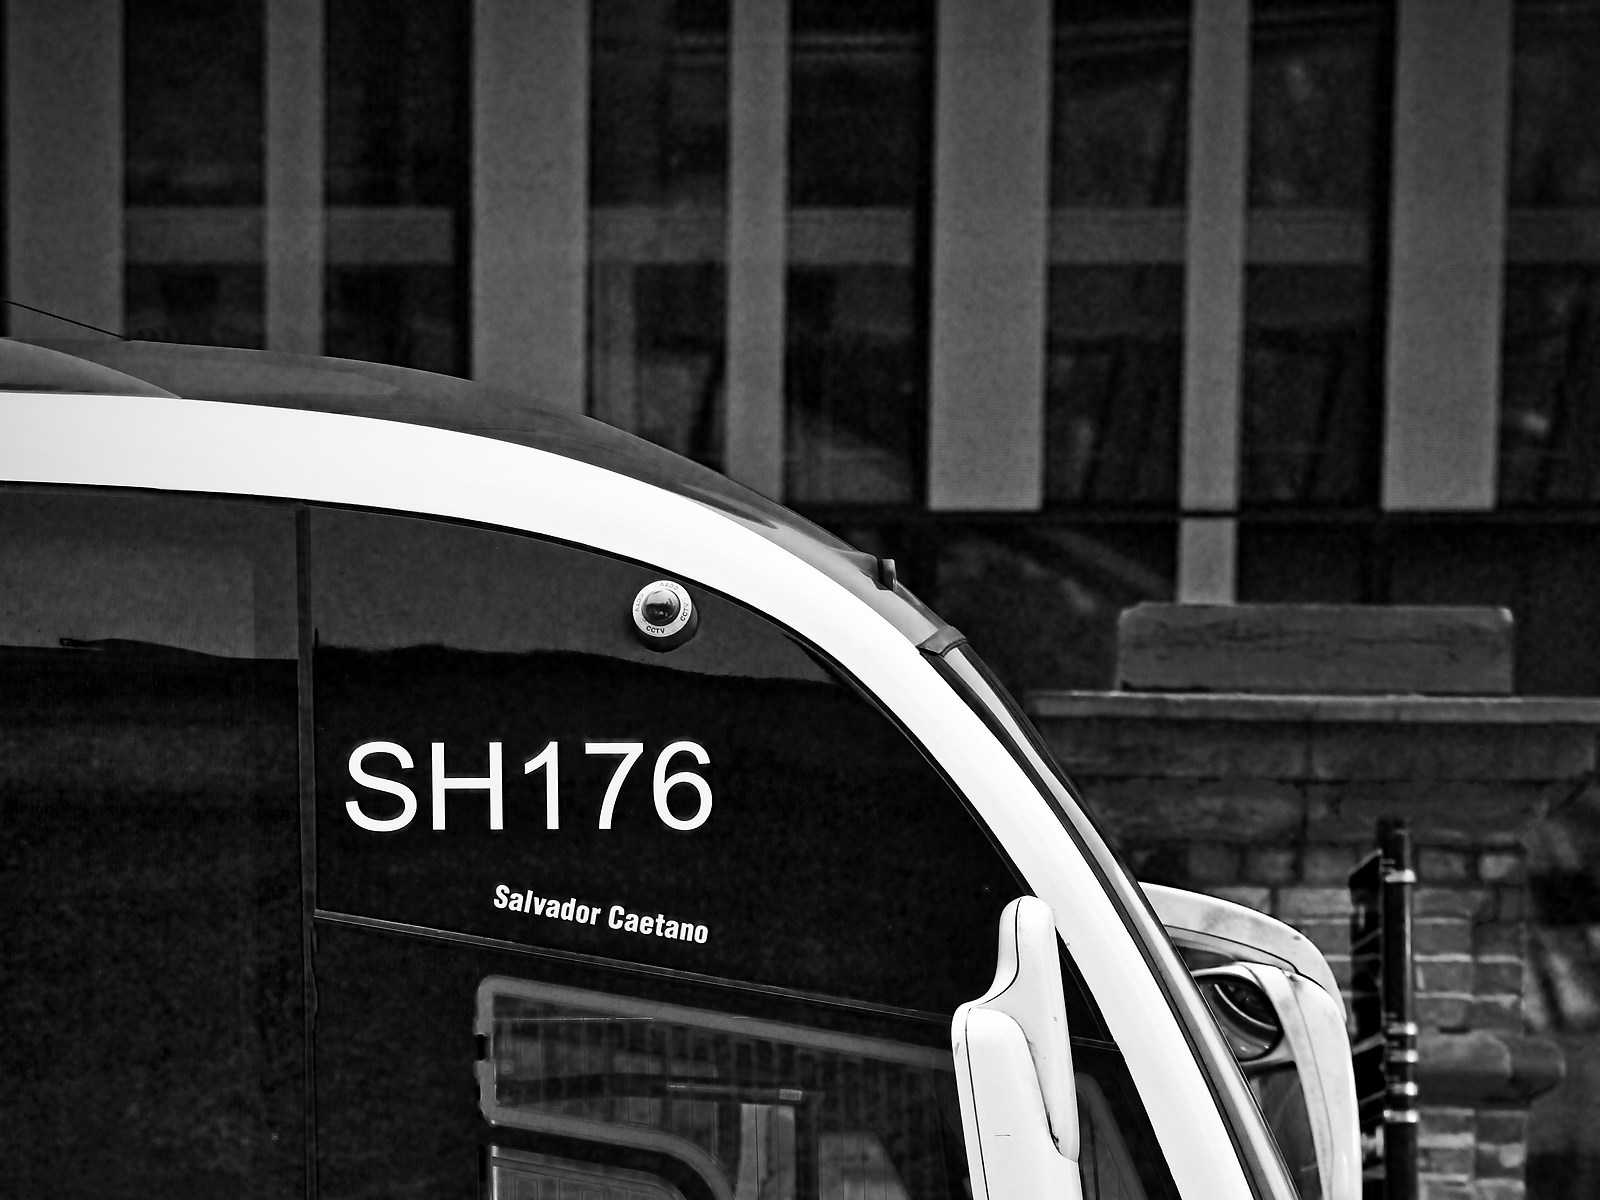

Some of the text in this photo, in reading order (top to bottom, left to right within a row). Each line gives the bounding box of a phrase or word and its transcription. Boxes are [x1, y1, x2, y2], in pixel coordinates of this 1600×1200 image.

[645, 625, 666, 634] CCTV
[345, 740, 713, 832] SH176
[493, 884, 709, 944] Salvador Caetano
